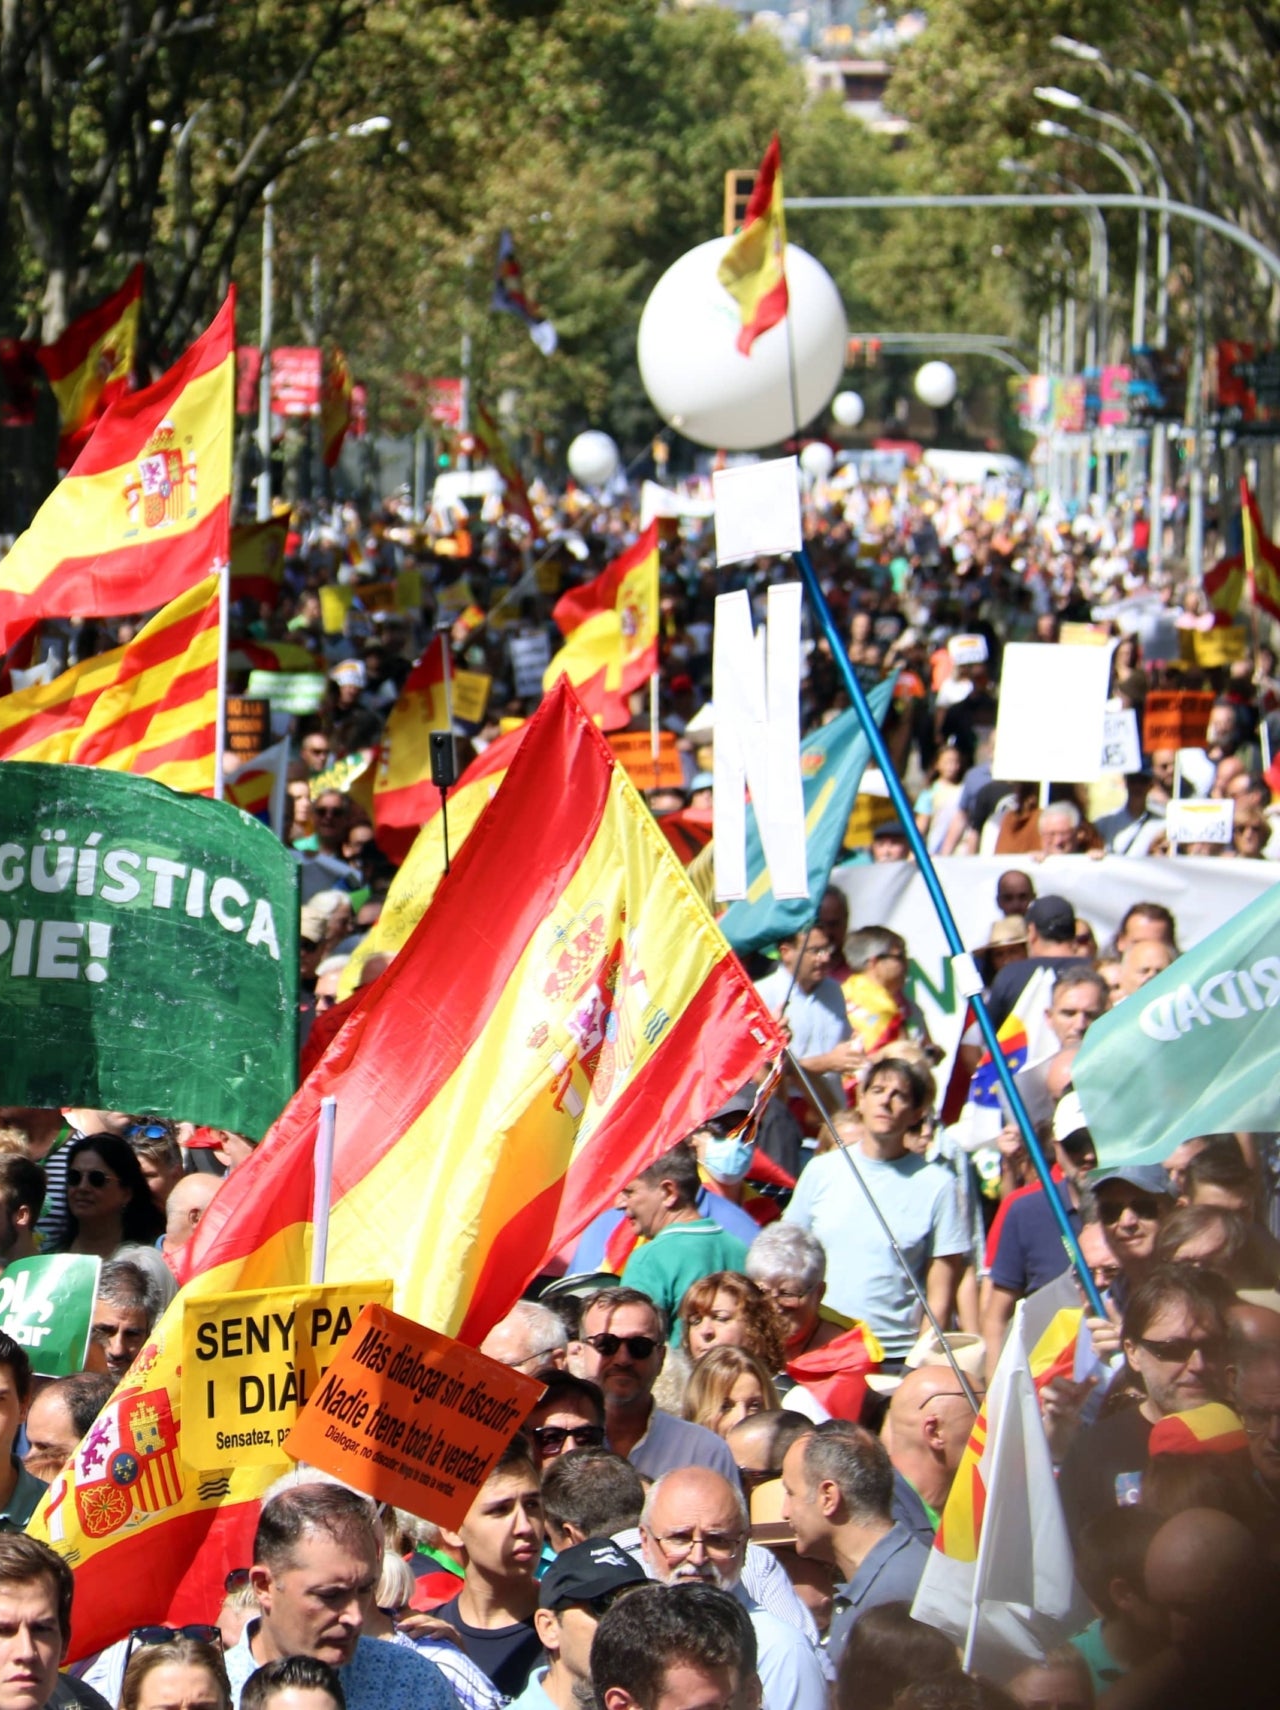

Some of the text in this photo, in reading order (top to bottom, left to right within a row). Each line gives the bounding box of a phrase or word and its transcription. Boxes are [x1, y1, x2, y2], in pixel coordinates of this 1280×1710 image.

[310, 1304, 381, 1348] PA
[207, 1362, 328, 1420] I DIÀL
[351, 1326, 392, 1375] Más
[387, 1344, 446, 1404] dialogar
[444, 1371, 464, 1410] sin
[216, 1427, 292, 1451] Sensatez, pa
[315, 1374, 370, 1429] Nadie
[365, 1402, 405, 1448] tiene
[401, 1418, 433, 1461] toda
[427, 1428, 445, 1467] la
[441, 1446, 493, 1488] verdad.
[324, 1424, 358, 1455] Dialogar,
[360, 1447, 372, 1459] no
